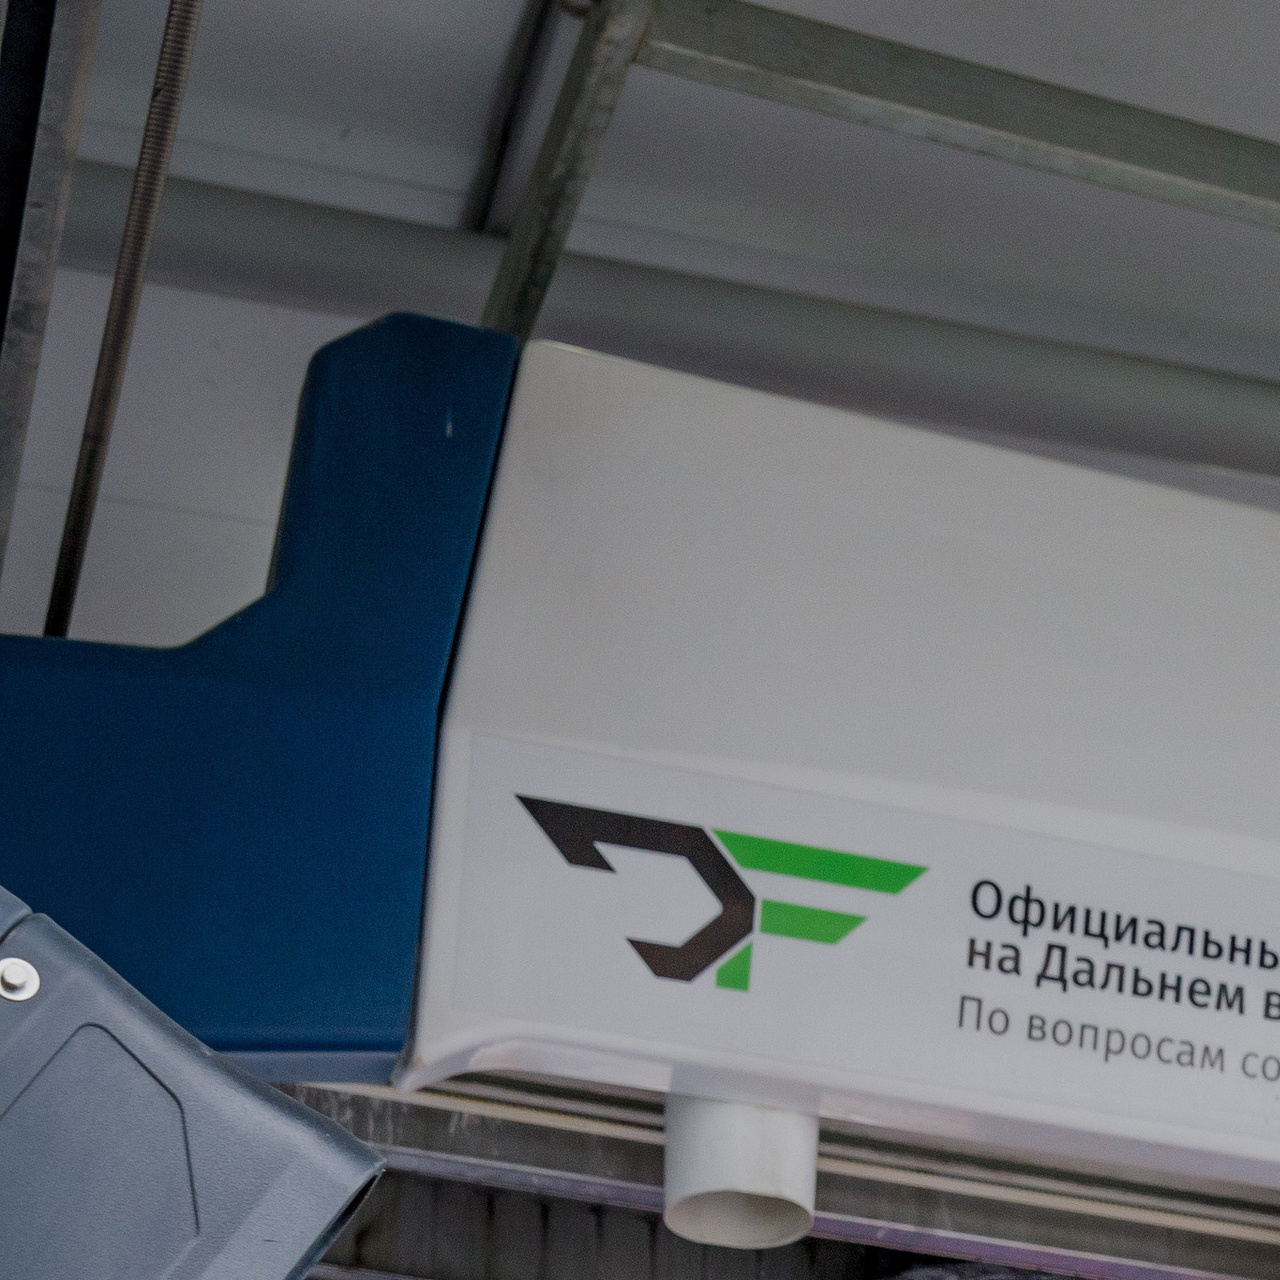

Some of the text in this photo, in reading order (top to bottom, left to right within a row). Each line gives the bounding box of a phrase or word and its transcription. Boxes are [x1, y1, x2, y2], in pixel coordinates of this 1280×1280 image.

[965, 936, 1022, 978] на
[1034, 941, 1247, 1017] Дальнем
[957, 994, 1011, 1037] По
[1026, 1013, 1226, 1073] вопросам
